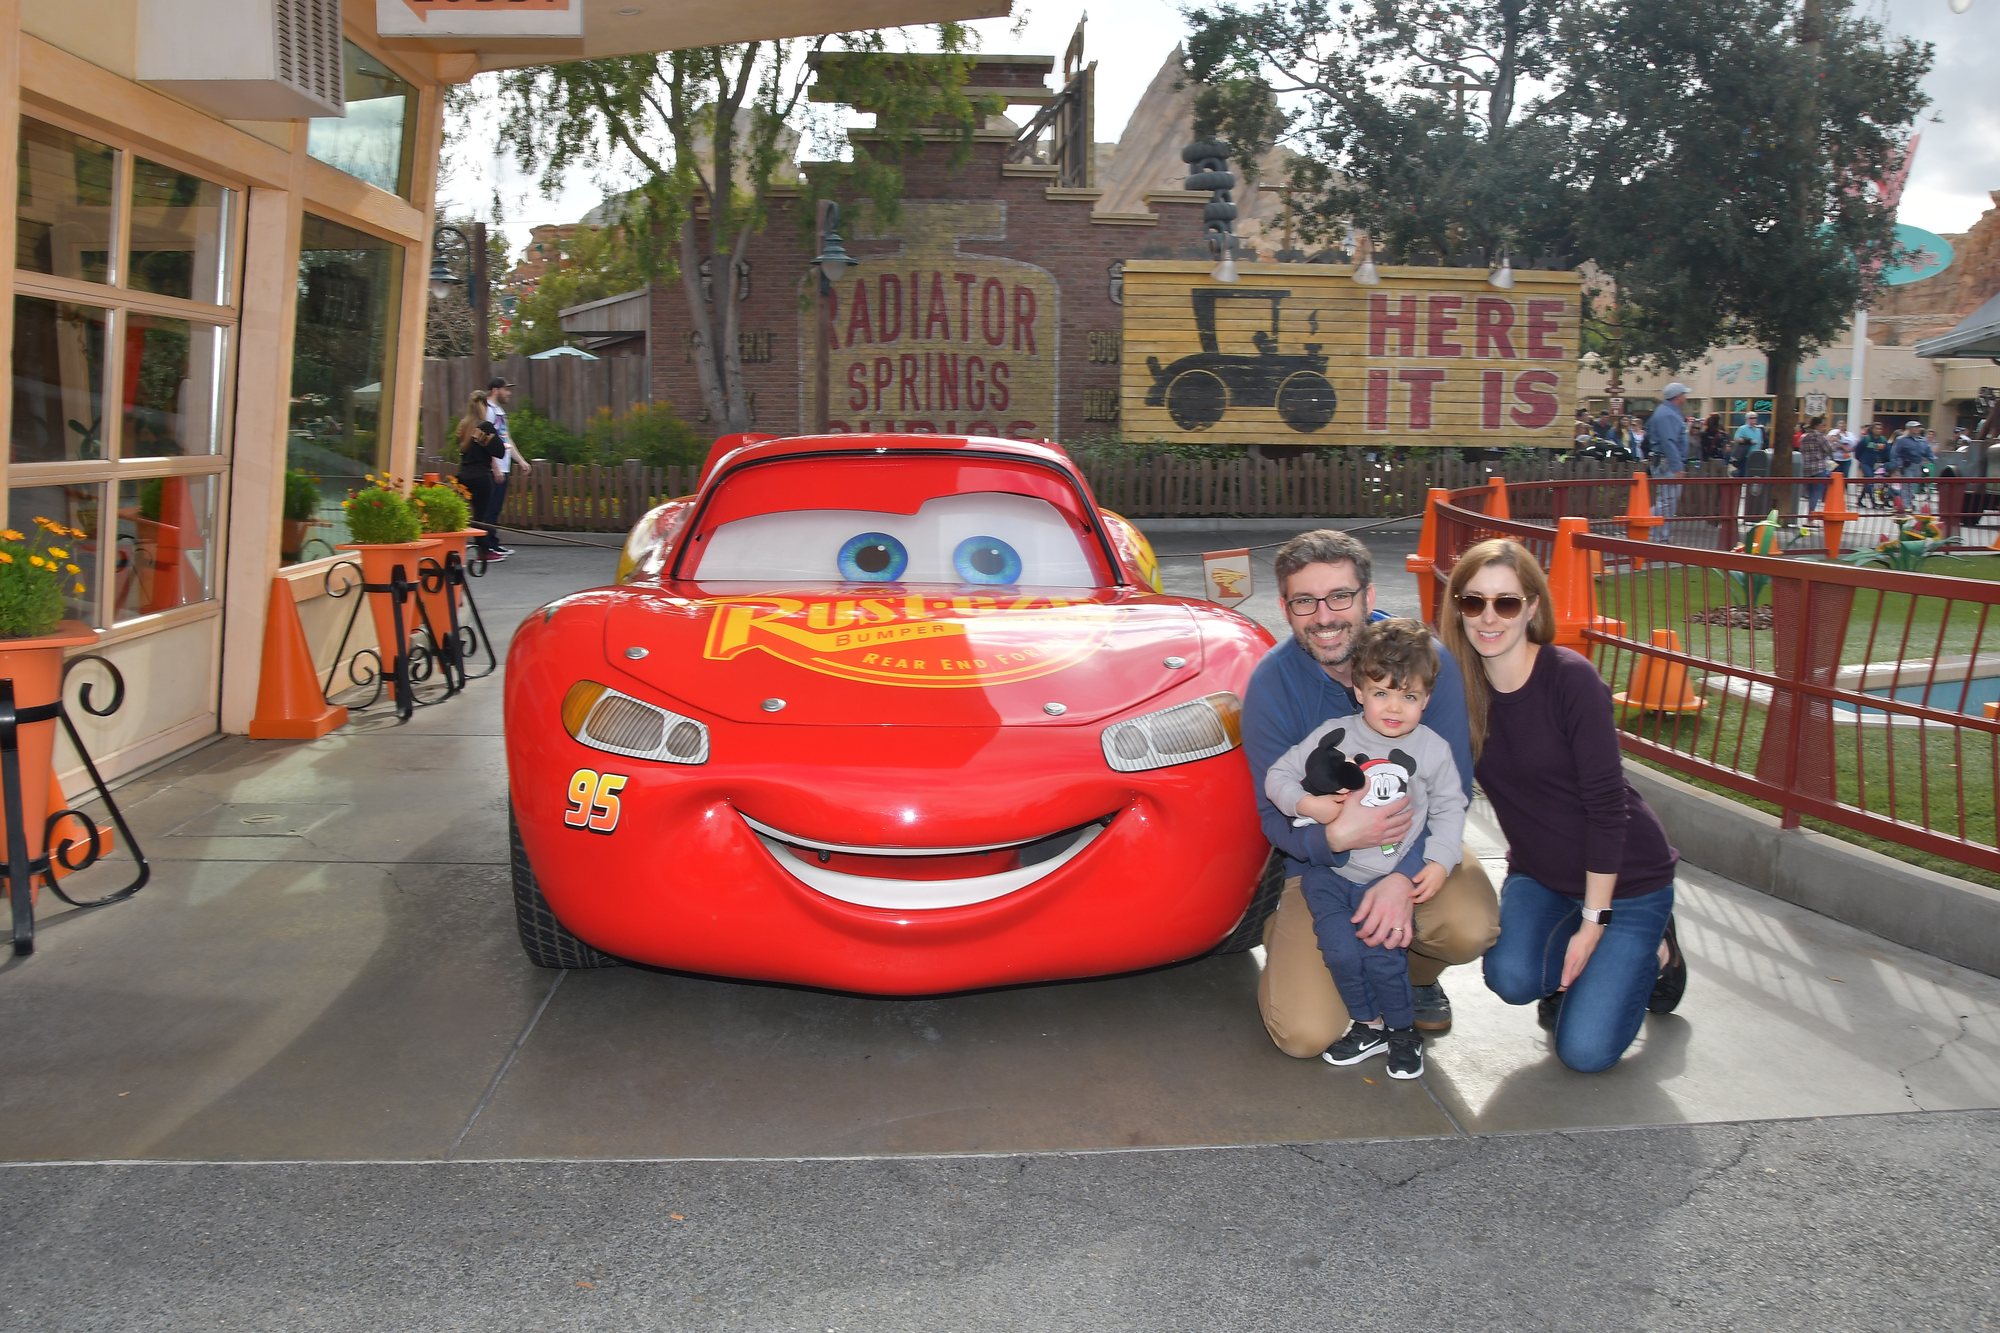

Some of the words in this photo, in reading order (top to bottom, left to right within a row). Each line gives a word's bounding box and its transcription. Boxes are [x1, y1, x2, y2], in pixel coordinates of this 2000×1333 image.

[828, 270, 1038, 355] RADIATOR
[1369, 293, 1567, 359] HERE
[847, 352, 1010, 412] SPRINGS
[1366, 368, 1445, 431] IT
[1482, 369, 1560, 430] IS
[835, 625, 946, 647] BUMPER
[862, 652, 926, 670] REAR
[940, 659, 988, 671] END
[564, 767, 629, 836] 95
